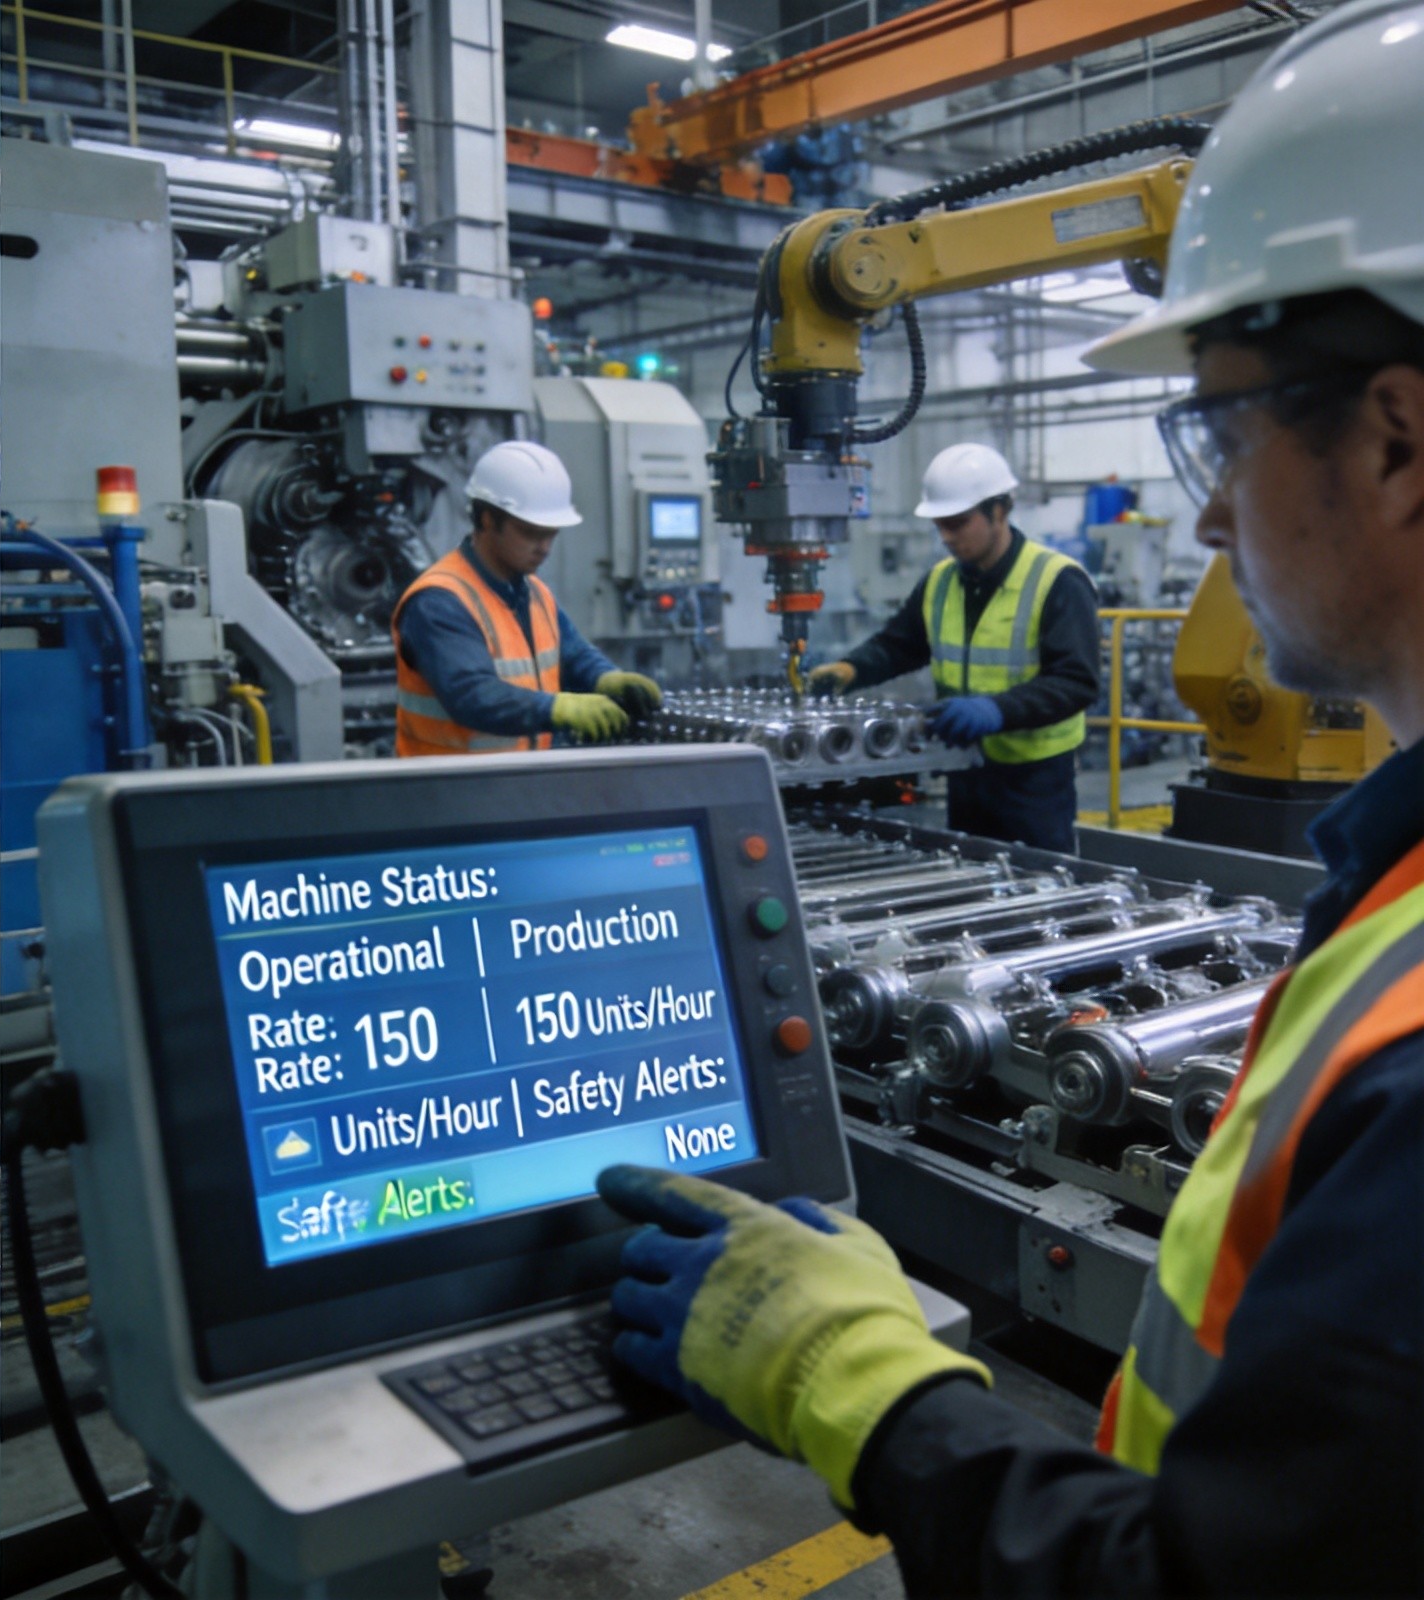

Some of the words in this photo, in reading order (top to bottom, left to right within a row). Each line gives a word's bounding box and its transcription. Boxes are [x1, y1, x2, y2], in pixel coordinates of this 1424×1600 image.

[223, 873, 371, 924] Machine
[381, 865, 497, 906] Status:
[510, 904, 678, 959] Production
[239, 926, 444, 999] Operational
[248, 1009, 337, 1050] Rate:
[354, 1006, 438, 1070] 150
[516, 991, 580, 1045] 150
[254, 1052, 343, 1093] Rate:
[331, 1095, 502, 1155] Units/Hour
[533, 1069, 624, 1118] Safety
[635, 1054, 726, 1101] Alerts:
[665, 1122, 736, 1163] None
